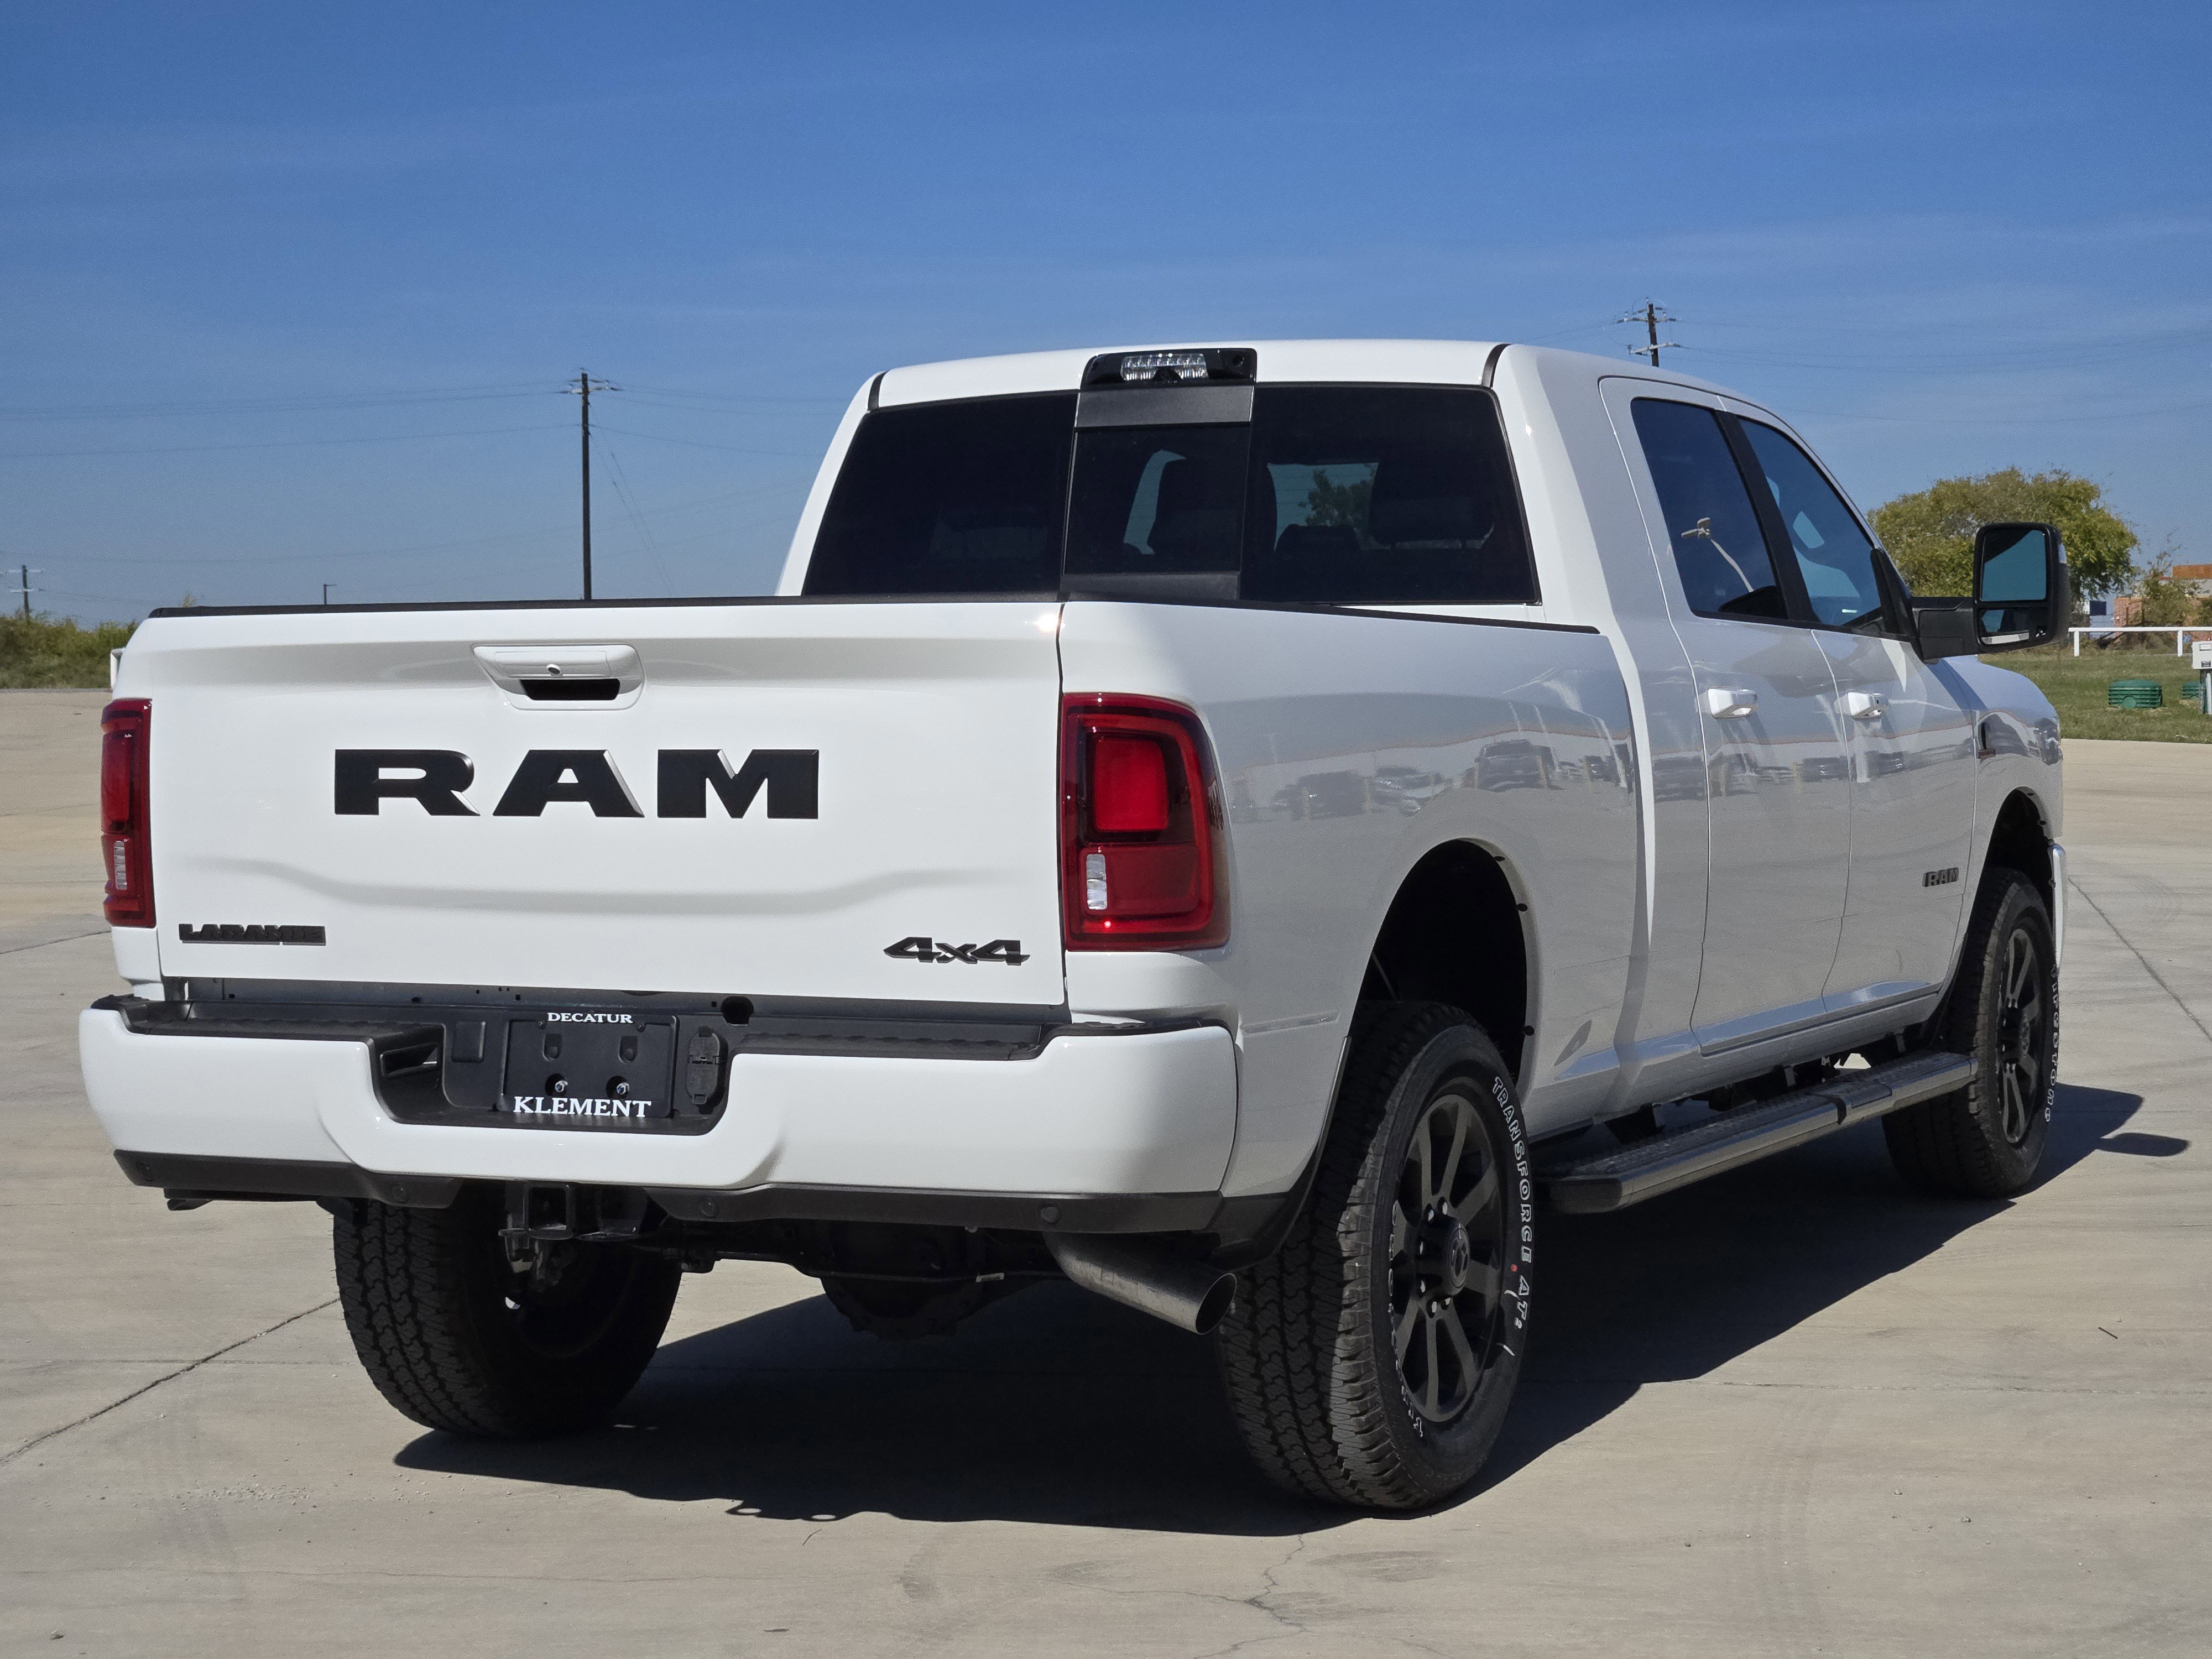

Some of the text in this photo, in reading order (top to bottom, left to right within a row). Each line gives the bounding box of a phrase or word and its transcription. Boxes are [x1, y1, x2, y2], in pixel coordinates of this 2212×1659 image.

[335, 749, 819, 819] RAM
[1922, 867, 1959, 888] RAM
[883, 936, 1030, 966] 4x4
[546, 1012, 634, 1024] DECATUR
[513, 1095, 652, 1118] KLEMENT
[1493, 1076, 1532, 1264] TRANSFORCE
